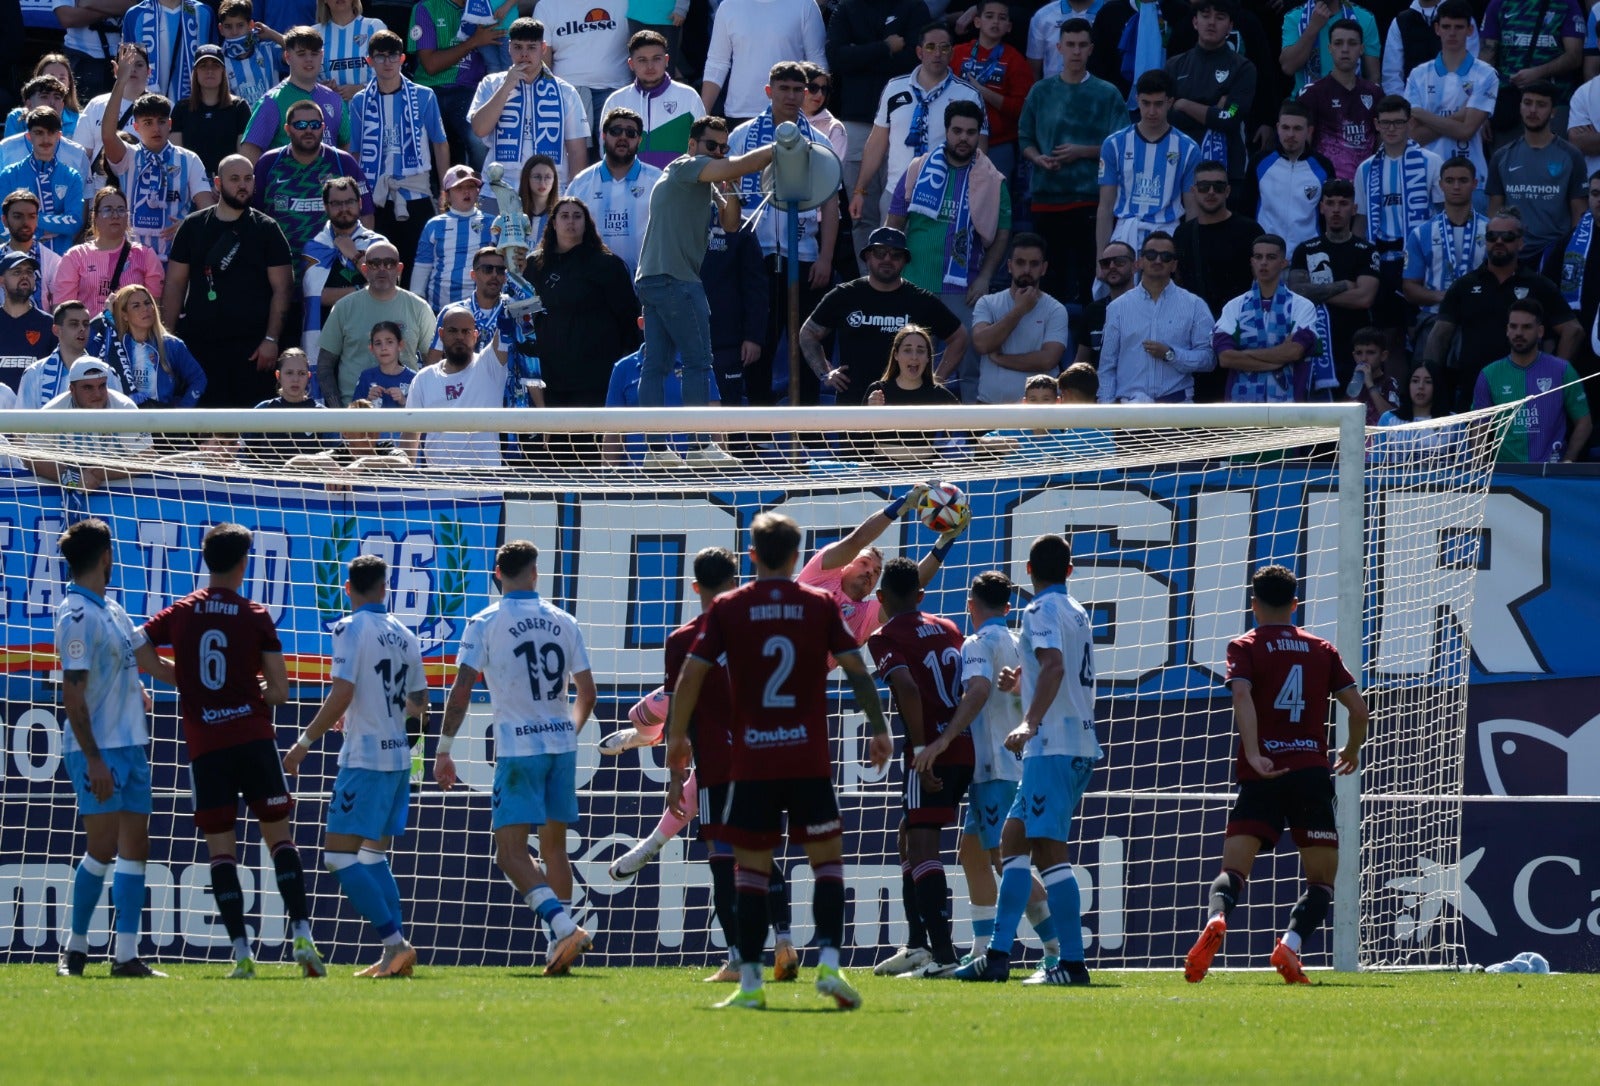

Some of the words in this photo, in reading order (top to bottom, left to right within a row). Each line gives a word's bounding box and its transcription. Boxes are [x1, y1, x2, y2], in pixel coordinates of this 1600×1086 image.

[556, 20, 617, 37] ellesse
[536, 81, 561, 144] SUR
[918, 147, 948, 190] UR
[1506, 185, 1560, 194] MARATHON
[290, 198, 326, 211] TESES
[604, 218, 629, 231] laga
[204, 601, 239, 616] TRAPERO
[508, 617, 561, 638] ROBERTO
[1276, 639, 1309, 653] SERRANO
[199, 629, 228, 691] 6
[513, 641, 566, 701] 19
[762, 635, 796, 708] 2
[922, 646, 961, 709] 12
[374, 658, 409, 717] 14
[1274, 664, 1306, 723] 4
[746, 724, 808, 744] Onubat
[1266, 737, 1319, 752] Onubat
